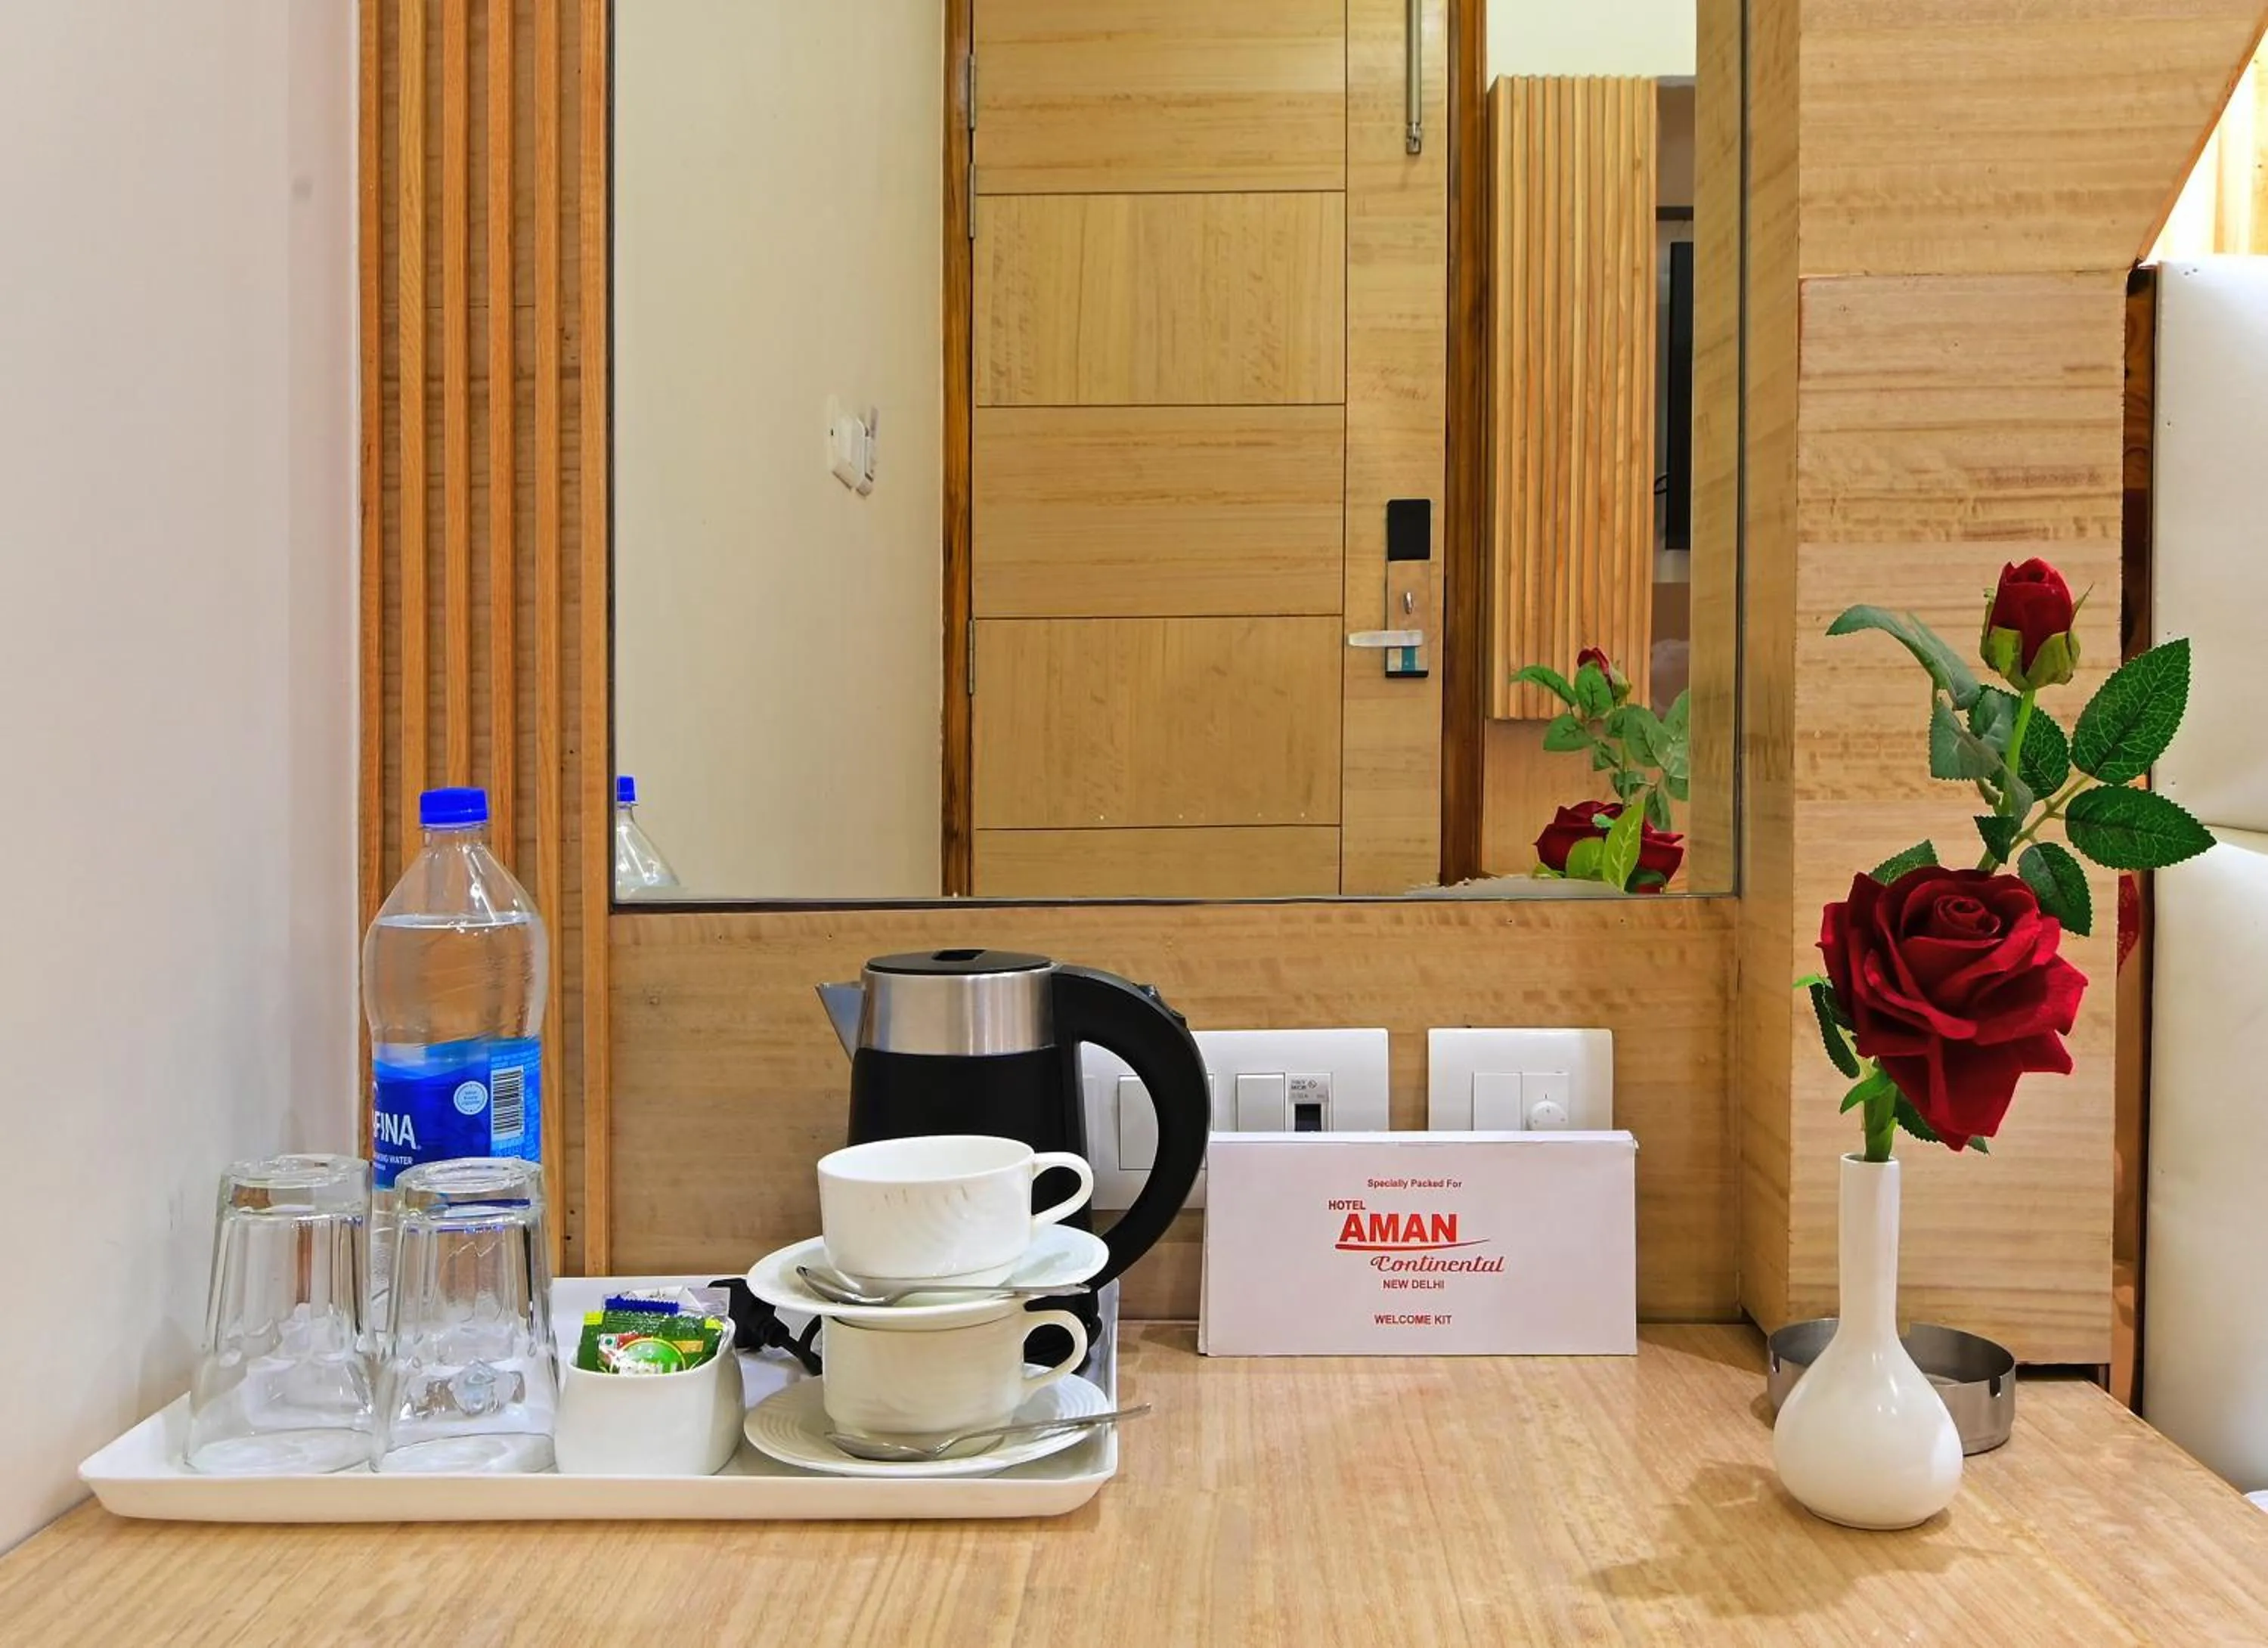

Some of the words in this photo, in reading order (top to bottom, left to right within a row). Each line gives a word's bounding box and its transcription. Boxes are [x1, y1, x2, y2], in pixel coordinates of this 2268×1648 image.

[389, 1156, 413, 1165] WATER
[1368, 1179, 1408, 1189] Specially
[1411, 1179, 1444, 1188] Packed
[1447, 1179, 1462, 1188] For
[1329, 1200, 1366, 1210] HOTEL
[1339, 1213, 1457, 1243] AMAN
[1371, 1255, 1504, 1272] Continental
[1383, 1279, 1408, 1289] NEW
[1411, 1280, 1444, 1289] DELHI
[1374, 1315, 1431, 1324] WELCOME
[1435, 1315, 1452, 1324] KIT
